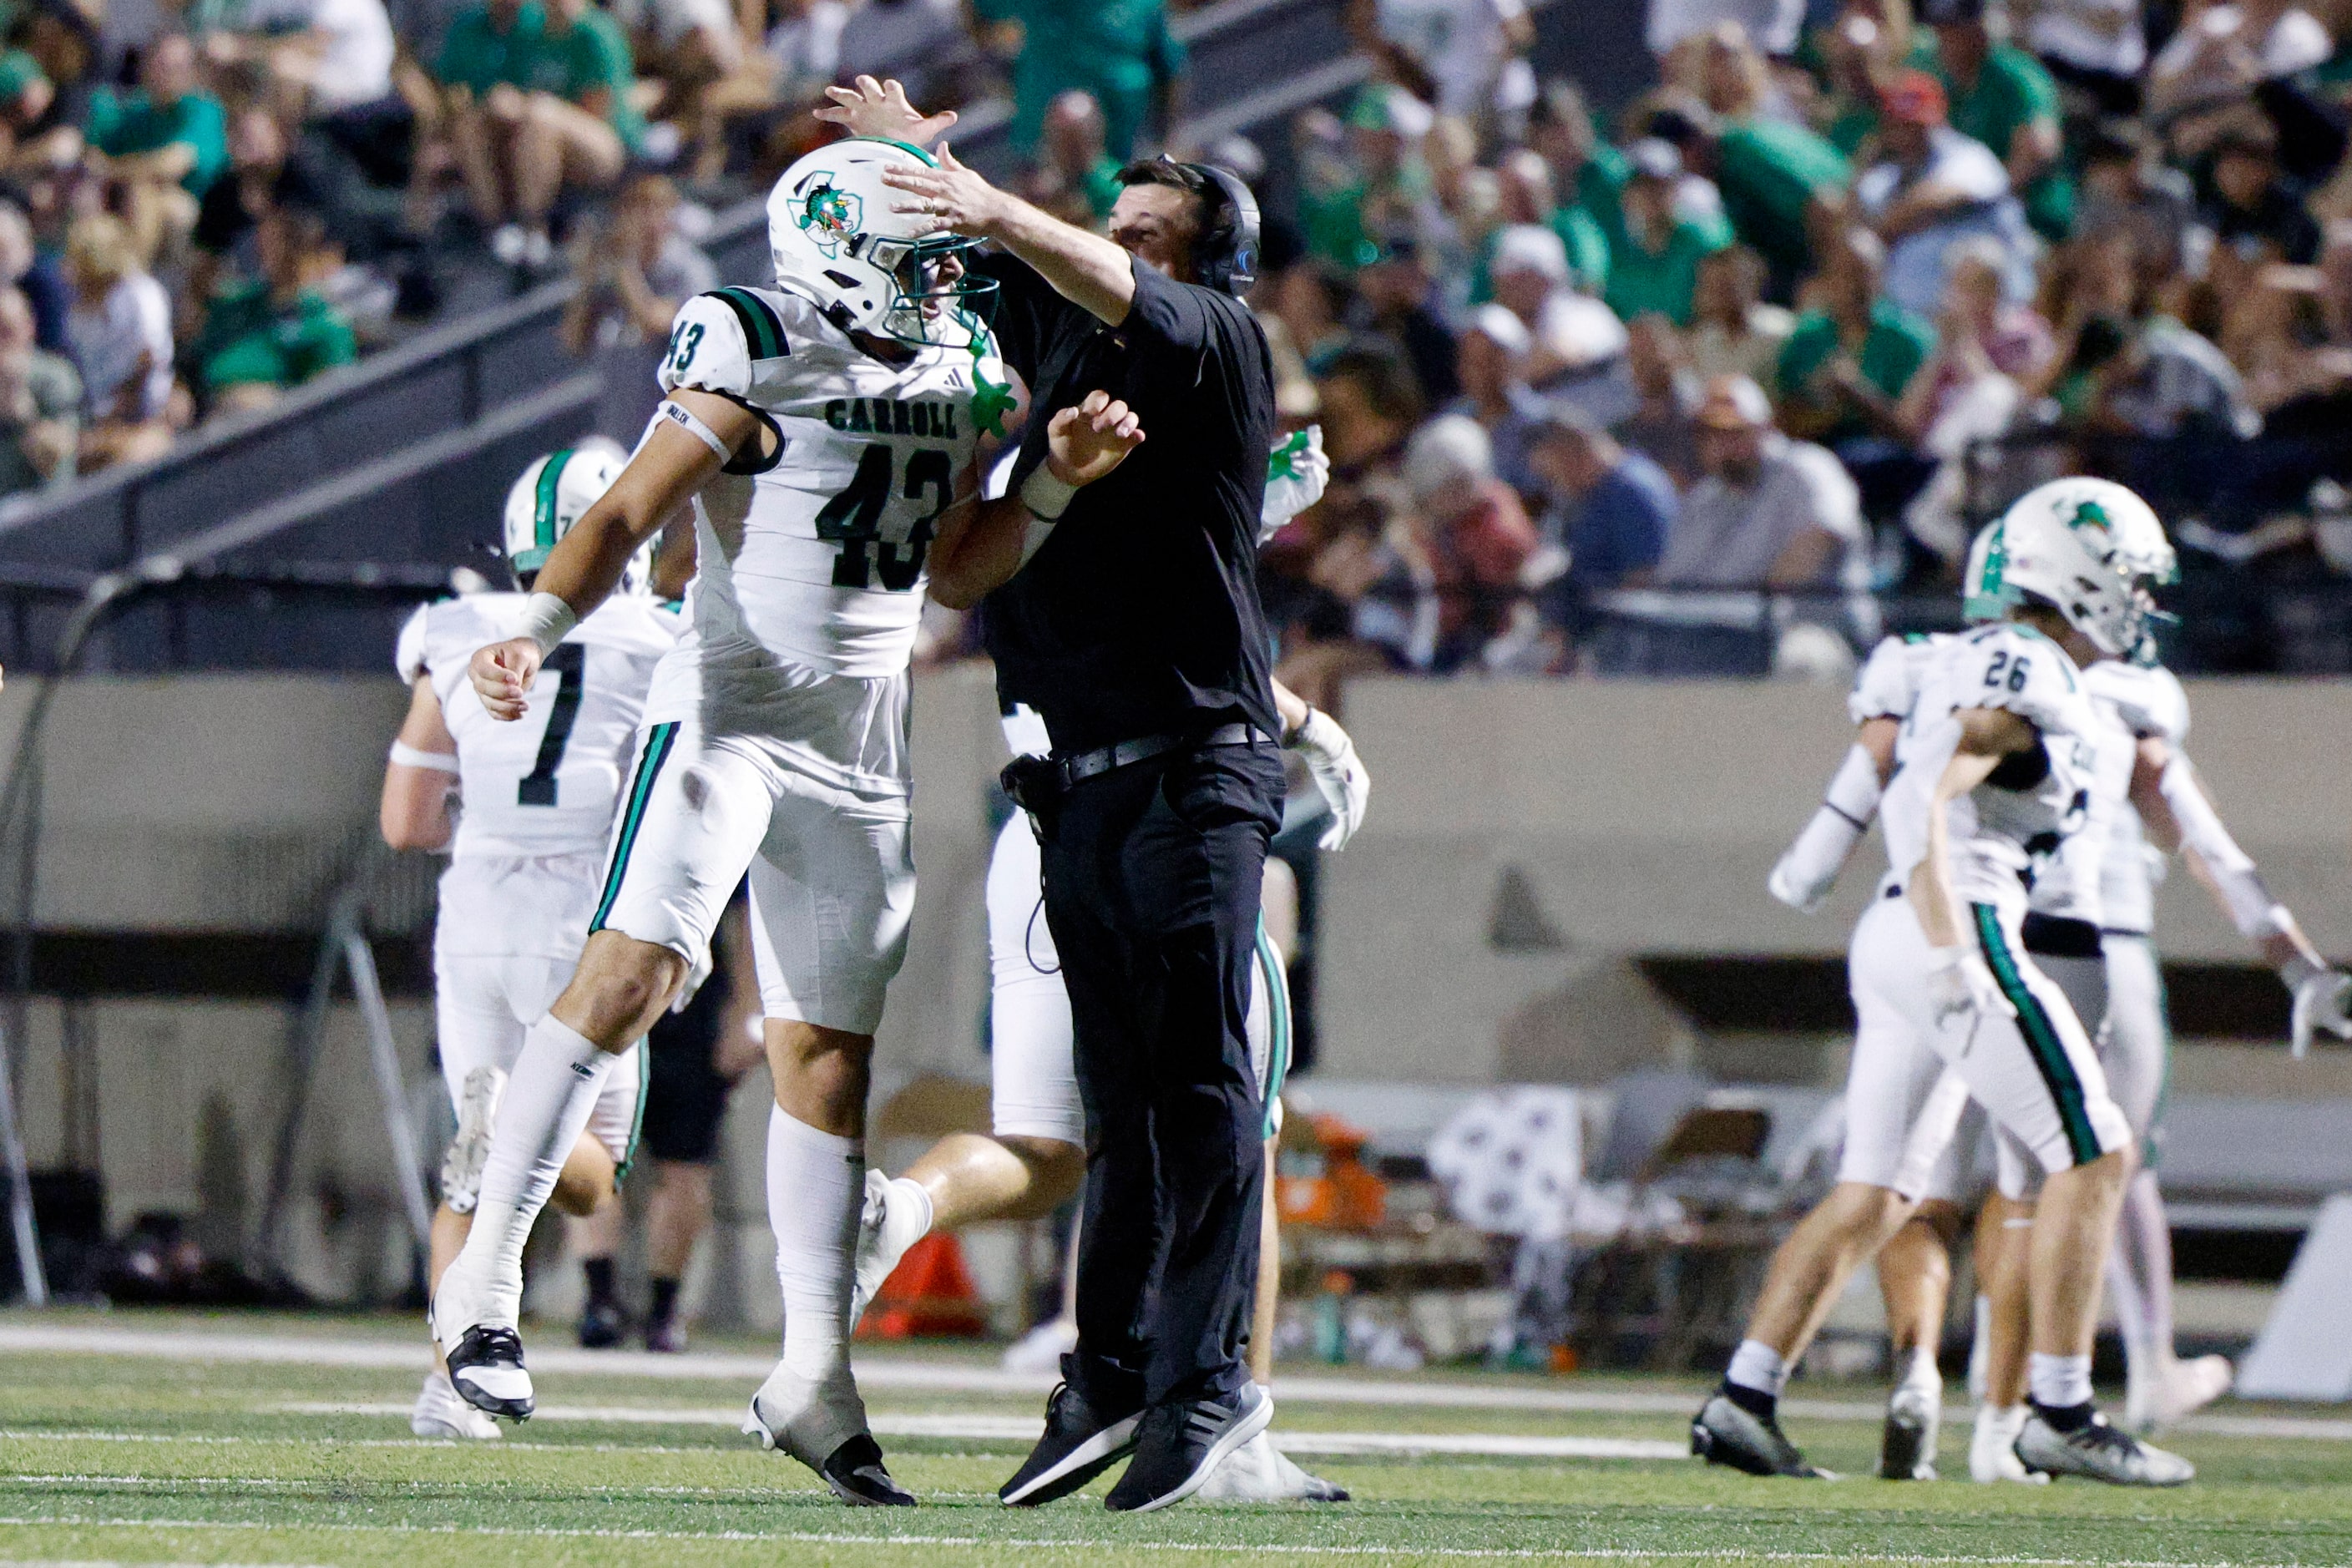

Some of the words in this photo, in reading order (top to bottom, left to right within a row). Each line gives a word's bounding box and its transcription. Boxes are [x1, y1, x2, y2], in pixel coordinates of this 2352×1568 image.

[665, 320, 706, 372] 43
[825, 398, 957, 439] CARROLL
[815, 444, 953, 591] 43
[1984, 651, 2031, 692] 26
[518, 642, 586, 802] 7
